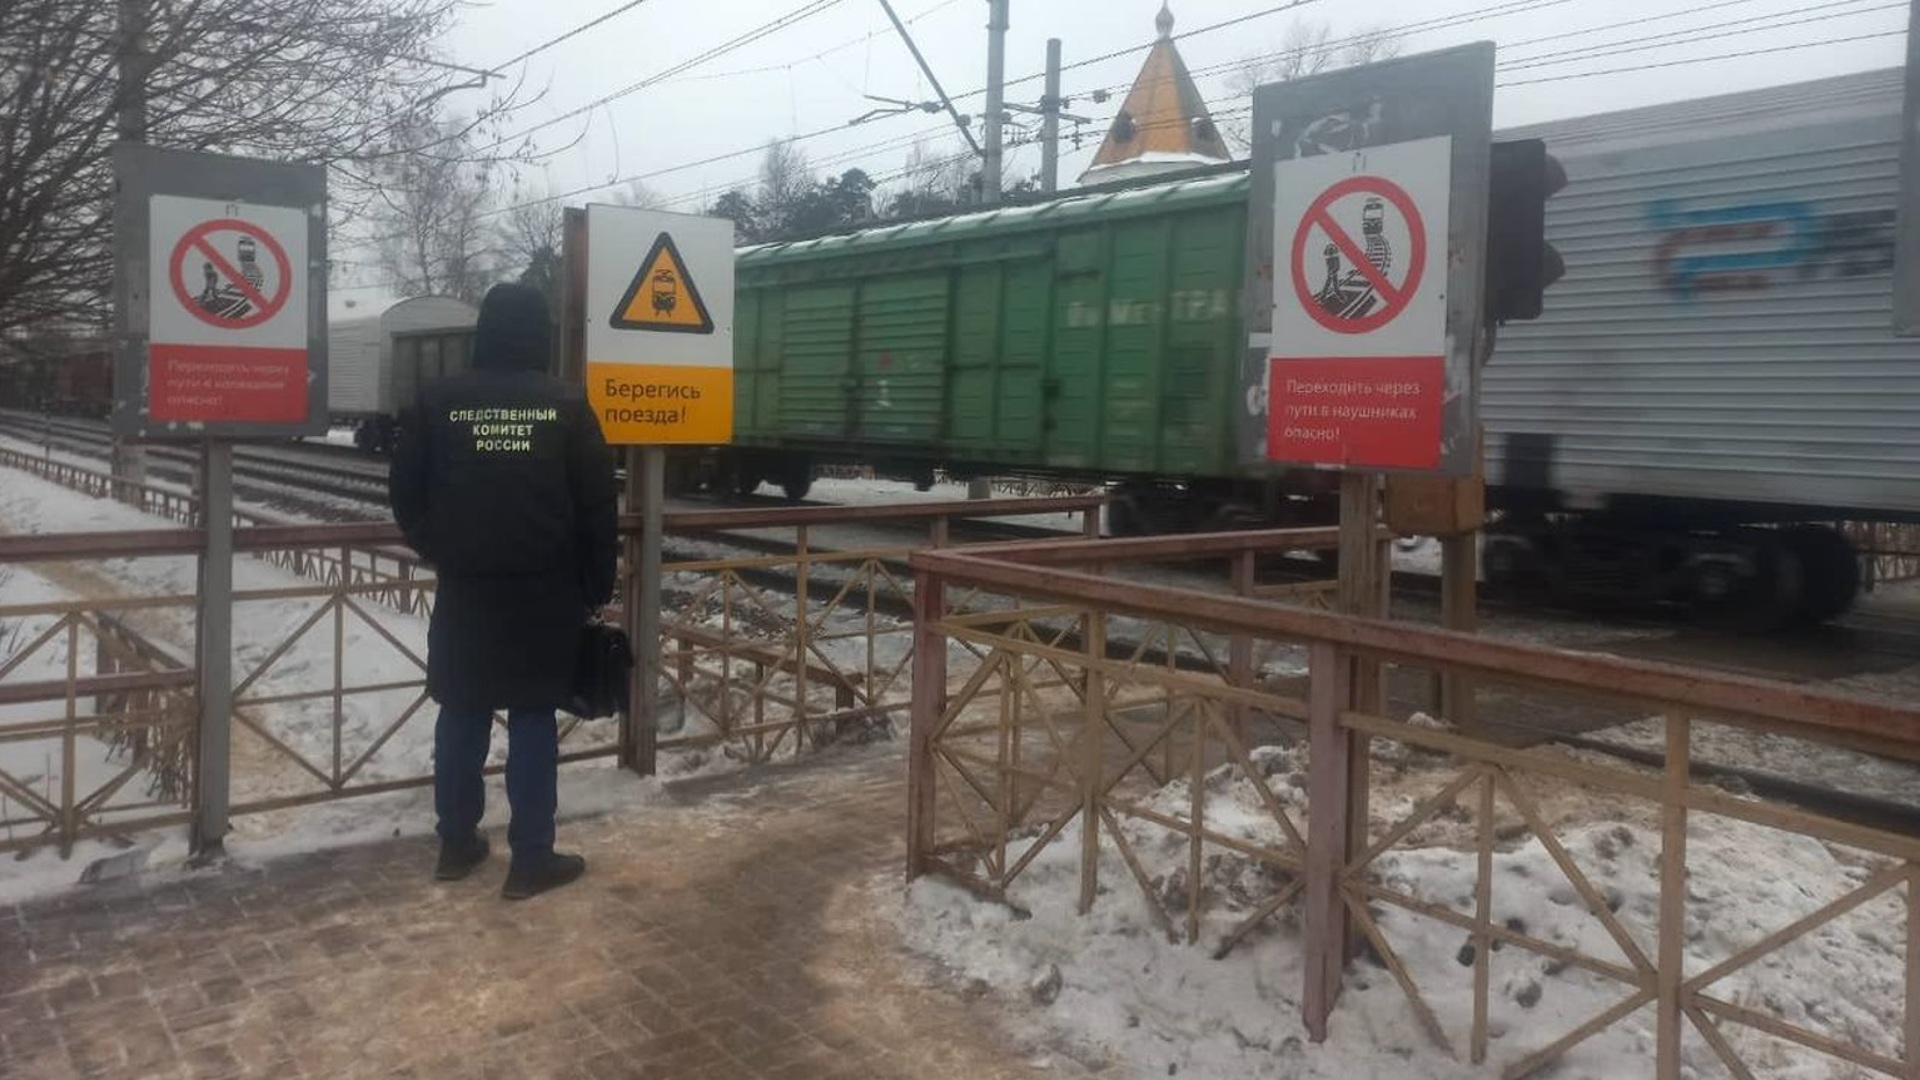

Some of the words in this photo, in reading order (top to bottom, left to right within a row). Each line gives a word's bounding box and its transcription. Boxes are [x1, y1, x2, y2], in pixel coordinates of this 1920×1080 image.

[605, 378, 701, 402] Берегись
[1286, 379, 1373, 396] Переходить
[1376, 382, 1421, 399] через
[449, 408, 557, 422] СЛЕДСТВЕННЫЙ
[605, 405, 686, 427] поезда!
[1286, 405, 1318, 420] пути
[1332, 405, 1417, 420] наушниках
[473, 424, 534, 436] КОМИТЕТ
[1284, 426, 1340, 441] опасно!
[476, 439, 531, 452] РОССИИ
